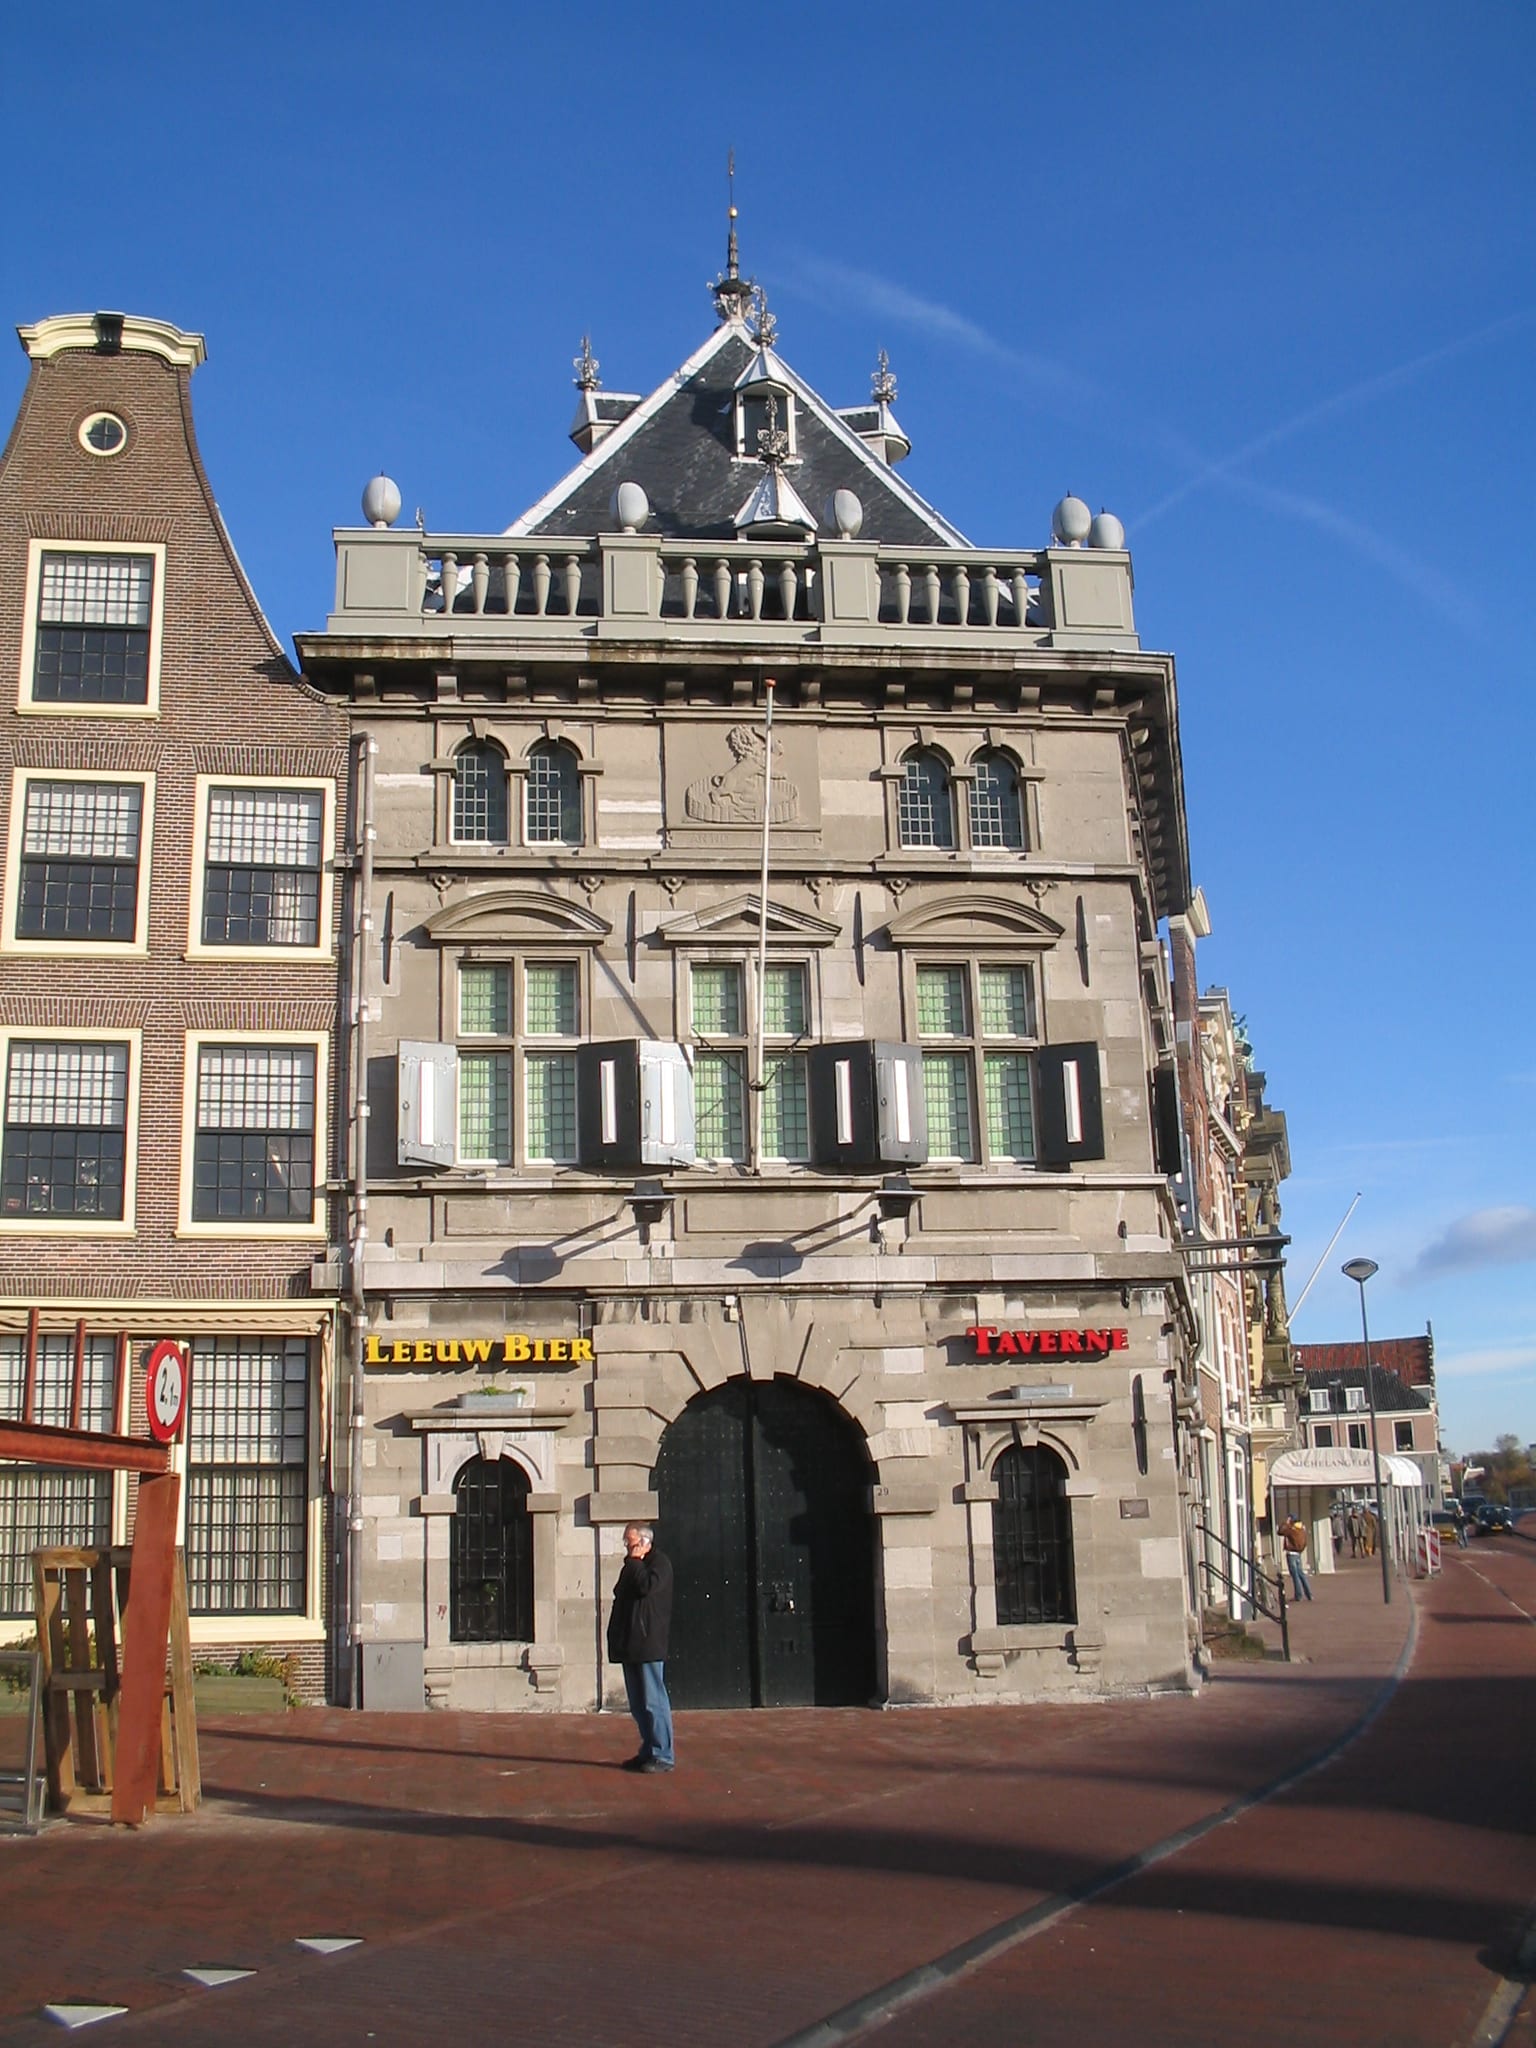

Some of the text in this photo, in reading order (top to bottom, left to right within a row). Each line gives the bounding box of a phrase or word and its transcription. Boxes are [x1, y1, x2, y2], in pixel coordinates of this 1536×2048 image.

[365, 1333, 595, 1363] LEEUW BIER
[966, 1326, 1129, 1355] TAVERNE
